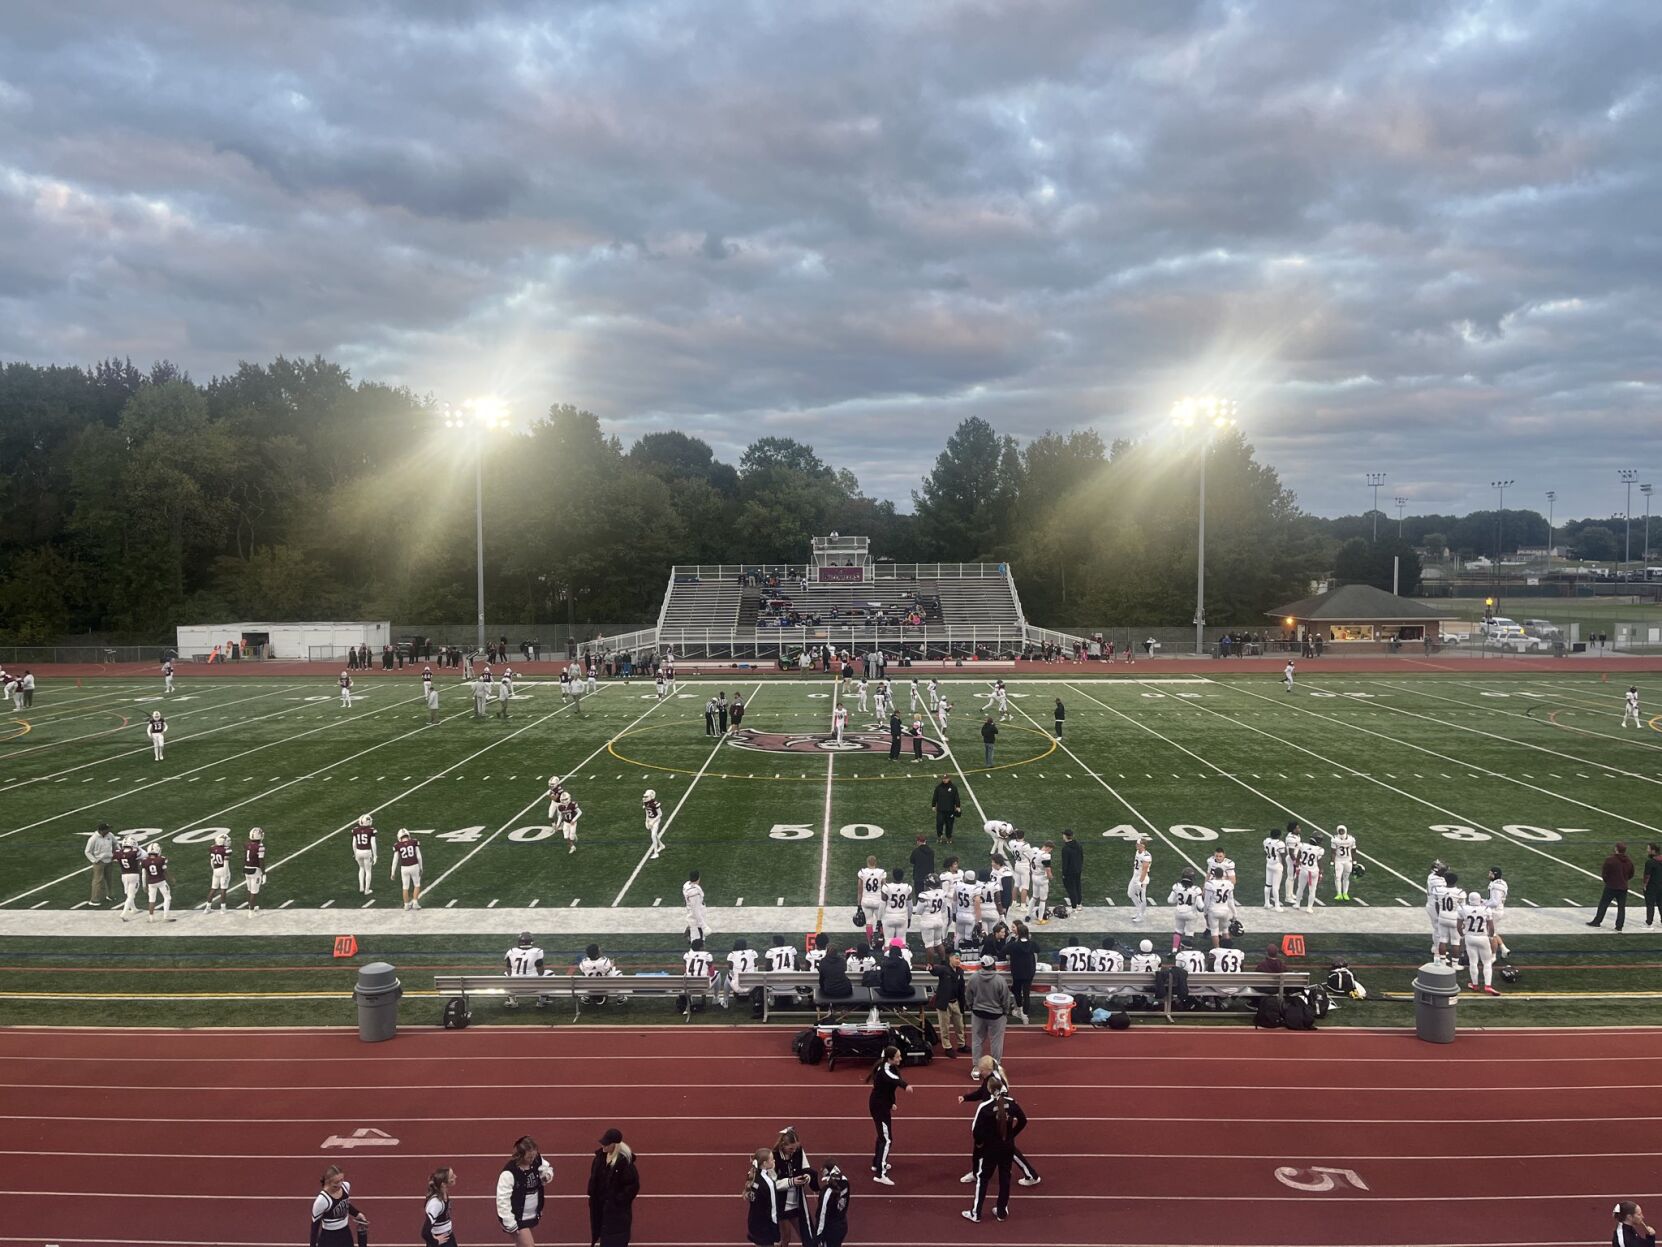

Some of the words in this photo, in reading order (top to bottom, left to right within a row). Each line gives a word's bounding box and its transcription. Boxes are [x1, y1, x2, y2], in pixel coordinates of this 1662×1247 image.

[154, 723, 162, 731] 13
[357, 834, 368, 845] 15
[211, 853, 223, 865] 20
[400, 845, 415, 859] 28
[1302, 851, 1316, 866] 28
[1339, 846, 1349, 857] 31
[121, 858, 131, 869] 5
[149, 864, 159, 876] 9
[866, 878, 879, 892] 68
[891, 894, 906, 909] 58
[958, 891, 970, 908] 55
[1177, 893, 1193, 906] 34
[1216, 889, 1229, 903] 56
[930, 898, 943, 914] 59
[1442, 897, 1453, 912] 10
[1467, 915, 1484, 933] 22
[336, 938, 352, 954] 40
[1288, 938, 1304, 954] 40
[515, 958, 529, 975] 71
[688, 958, 705, 976] 47
[776, 953, 791, 970] 74
[1070, 952, 1086, 972] 25
[1098, 957, 1114, 972] 52
[1221, 955, 1238, 972] 63
[320, 1128, 401, 1149] 4
[1274, 1166, 1370, 1192] 5
